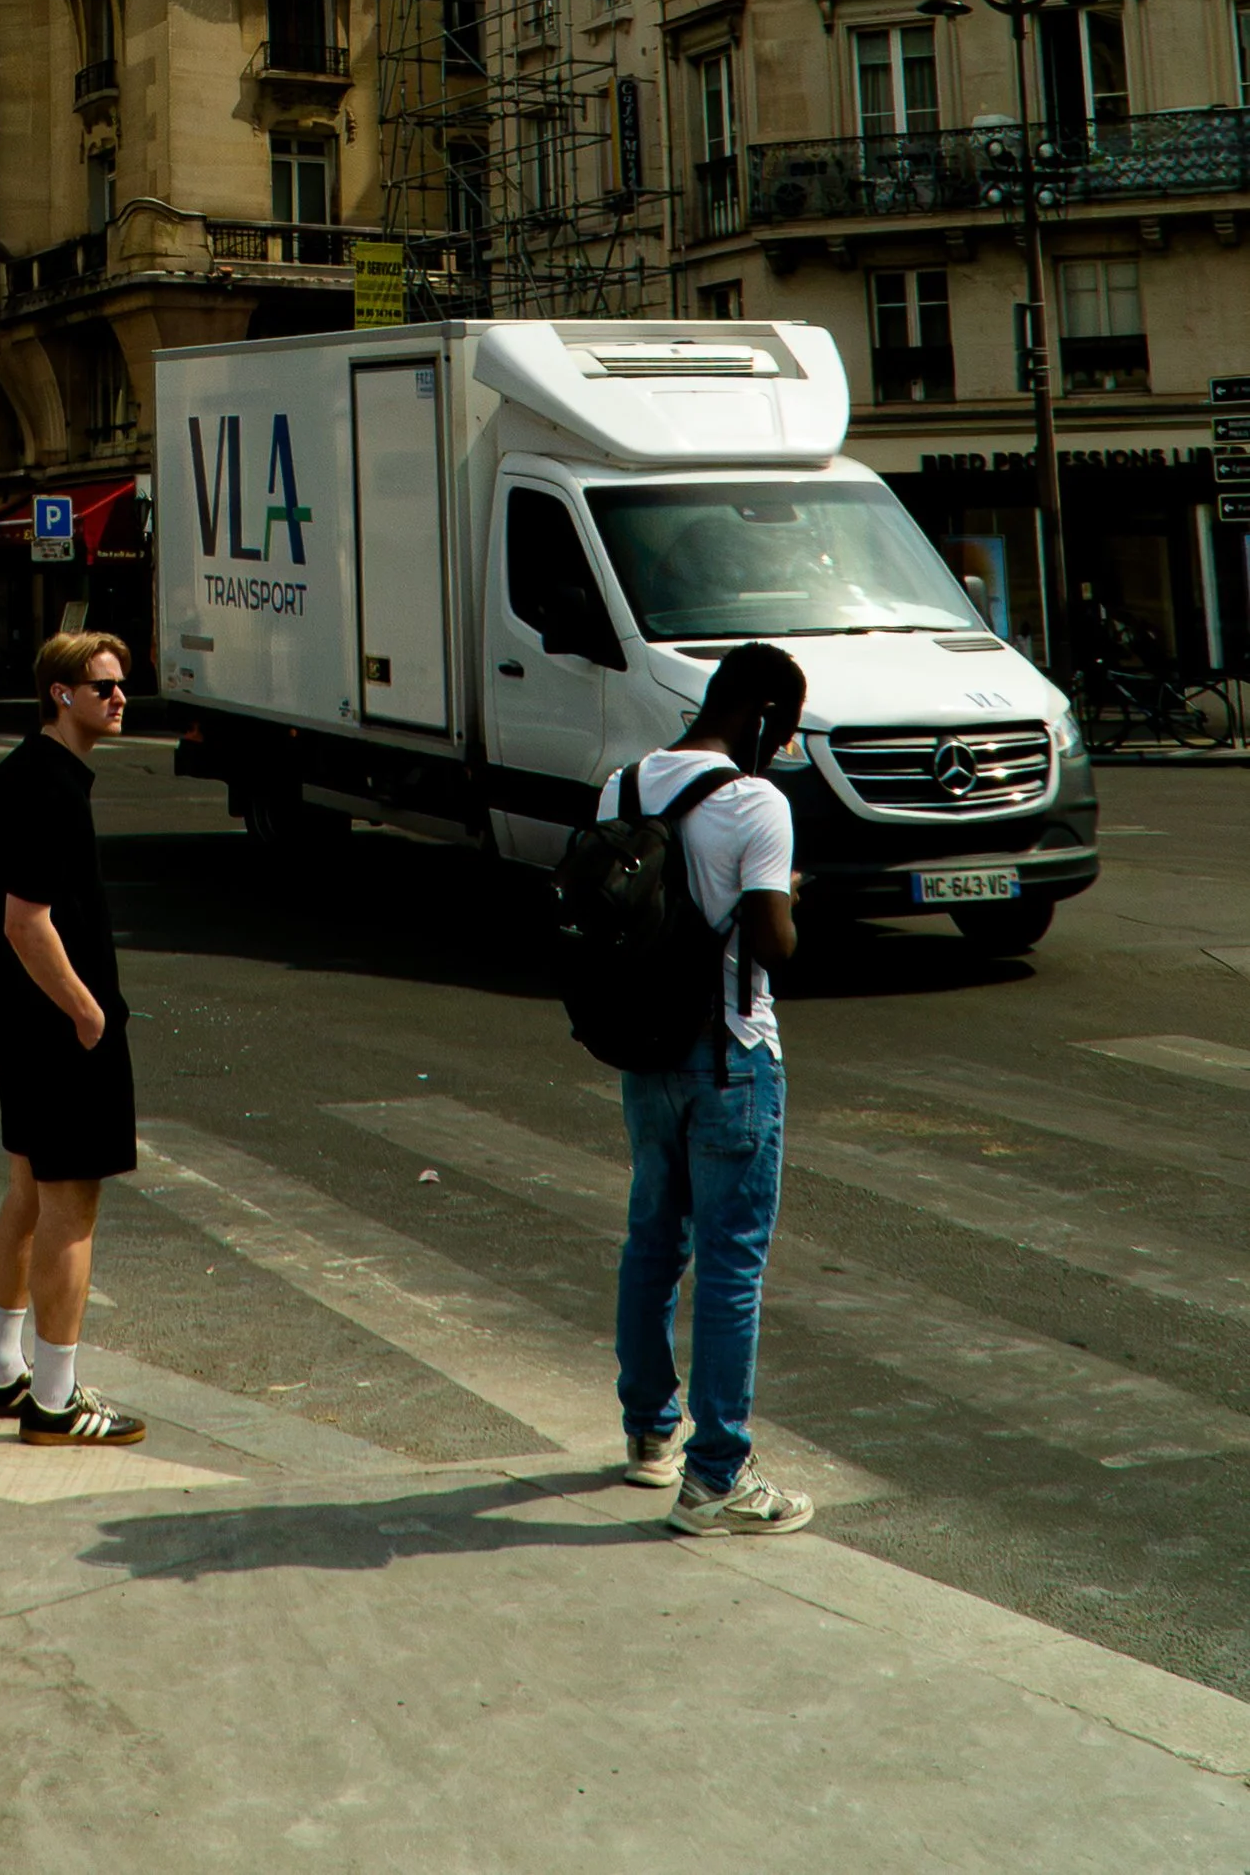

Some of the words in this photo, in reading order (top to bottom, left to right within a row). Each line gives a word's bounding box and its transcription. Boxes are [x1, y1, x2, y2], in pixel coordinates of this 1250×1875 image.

[993, 446, 1167, 474] PROESSIONS
[188, 413, 313, 565] VLA
[46, 505, 62, 530] P
[203, 574, 307, 617] TRANSPORT
